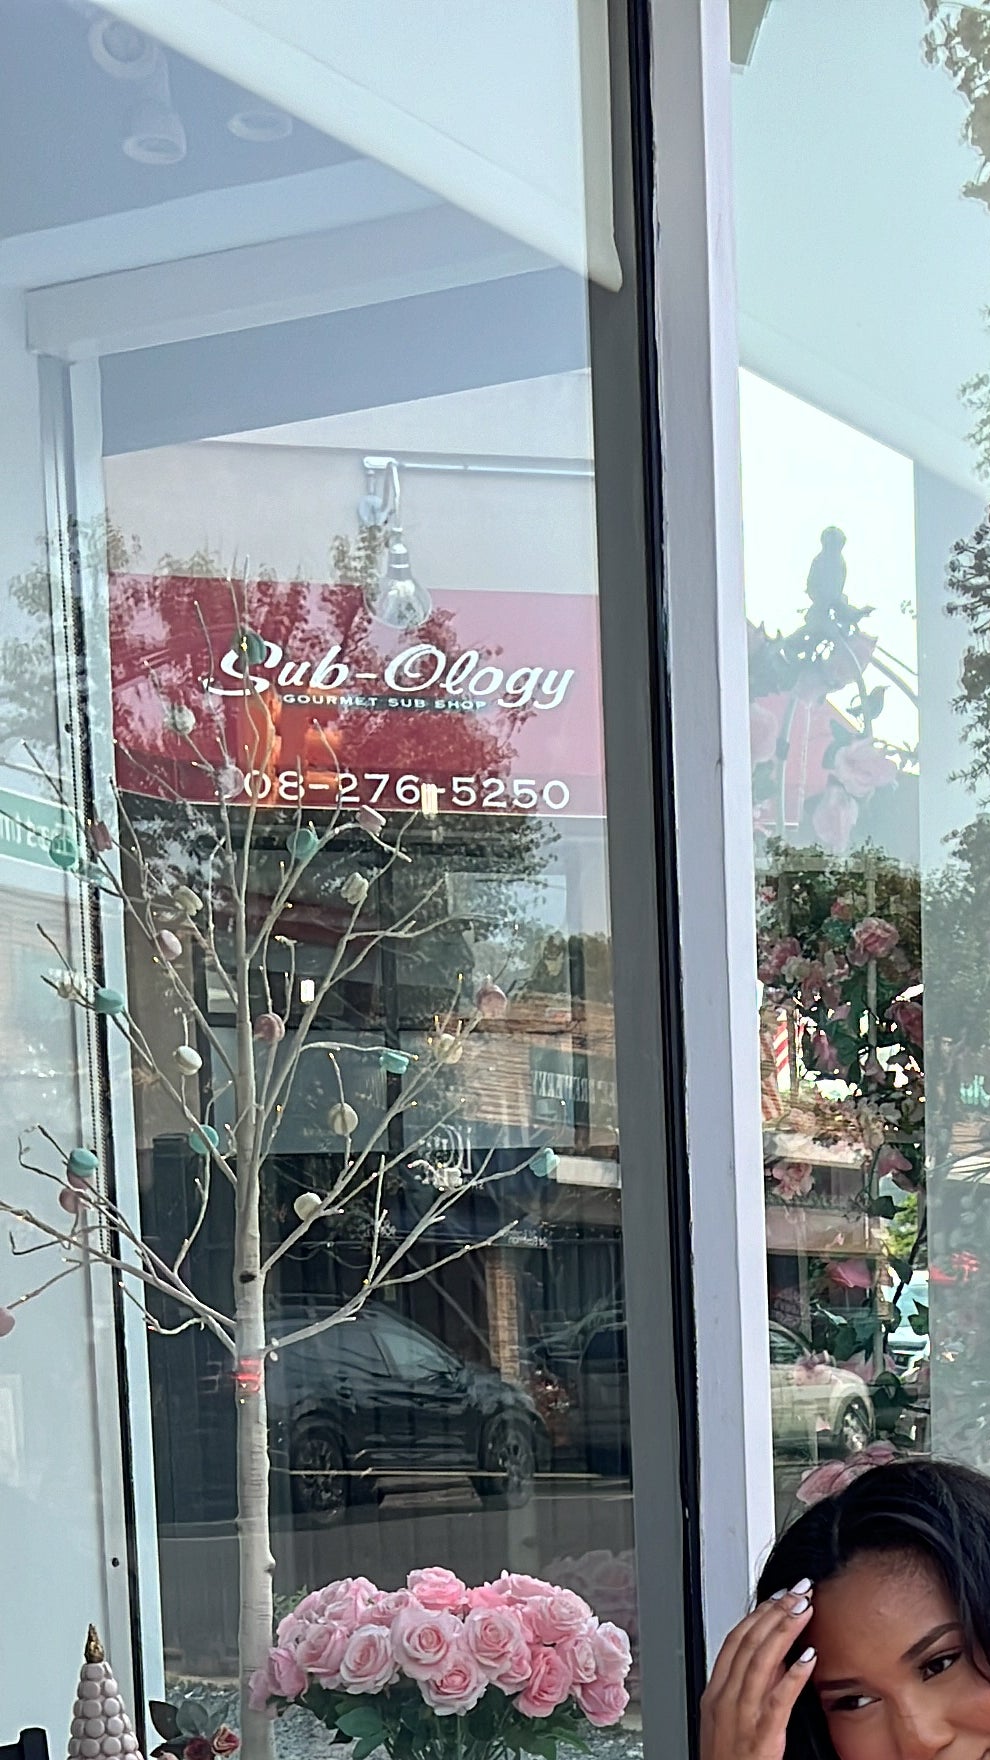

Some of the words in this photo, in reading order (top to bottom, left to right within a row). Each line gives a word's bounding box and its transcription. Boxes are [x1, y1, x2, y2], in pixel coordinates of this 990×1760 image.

[202, 641, 575, 709] Sub-Ology
[283, 694, 378, 707] GOURMET
[387, 697, 427, 709] SUB
[434, 698, 487, 711] SHOP
[222, 768, 571, 810] 08-276-5250
